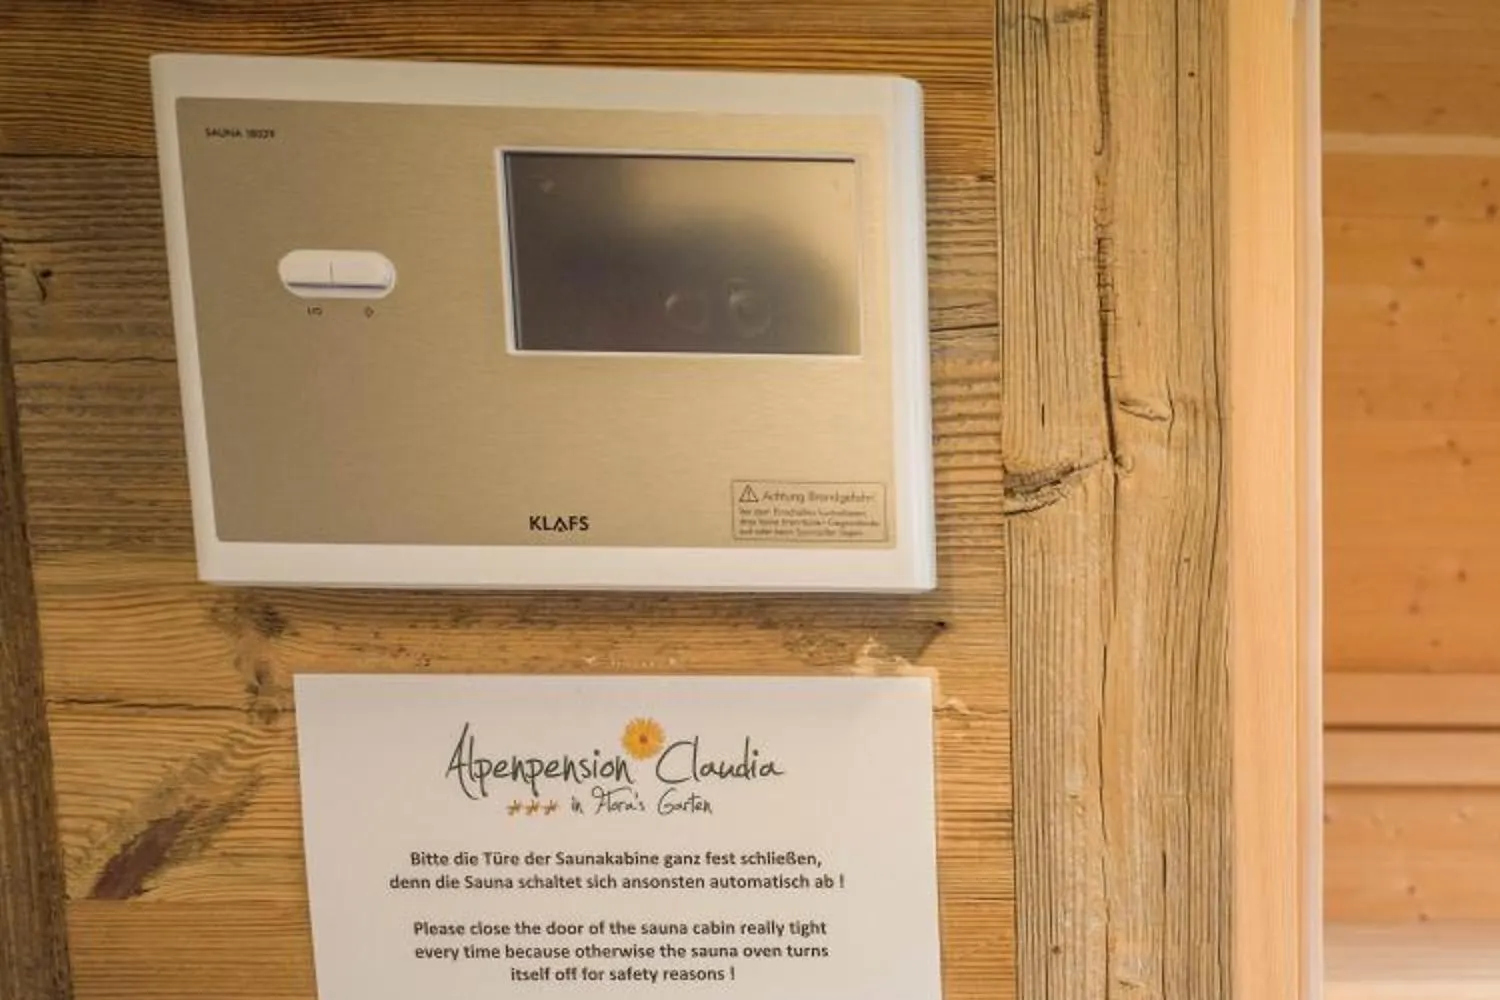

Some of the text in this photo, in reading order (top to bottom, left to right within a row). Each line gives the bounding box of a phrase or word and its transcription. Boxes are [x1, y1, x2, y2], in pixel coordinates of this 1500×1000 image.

[205, 127, 242, 138] SAUNA
[529, 515, 590, 532] KLAFS
[445, 722, 784, 800] Alpenpension Claudia
[571, 796, 583, 814] in
[657, 787, 713, 816] Garten
[409, 850, 823, 870] Bitte die Türe der Saunakabine ganz fest schließen,
[389, 873, 432, 890] denn
[434, 873, 461, 890] die
[463, 874, 515, 890] Sauna
[517, 873, 583, 890] schaltet
[585, 873, 619, 890] sich
[621, 874, 706, 890] ansonsten
[708, 872, 811, 890] automatisch
[813, 873, 835, 890] ab
[413, 918, 828, 939] Please close the door of the sauna cabin really tight
[414, 943, 829, 962] every time because otherwise the sauna oven turns
[510, 966, 552, 982] itself
[554, 966, 578, 982] off
[580, 965, 606, 982] for
[608, 965, 659, 984] safety
[662, 968, 726, 982] reasons
